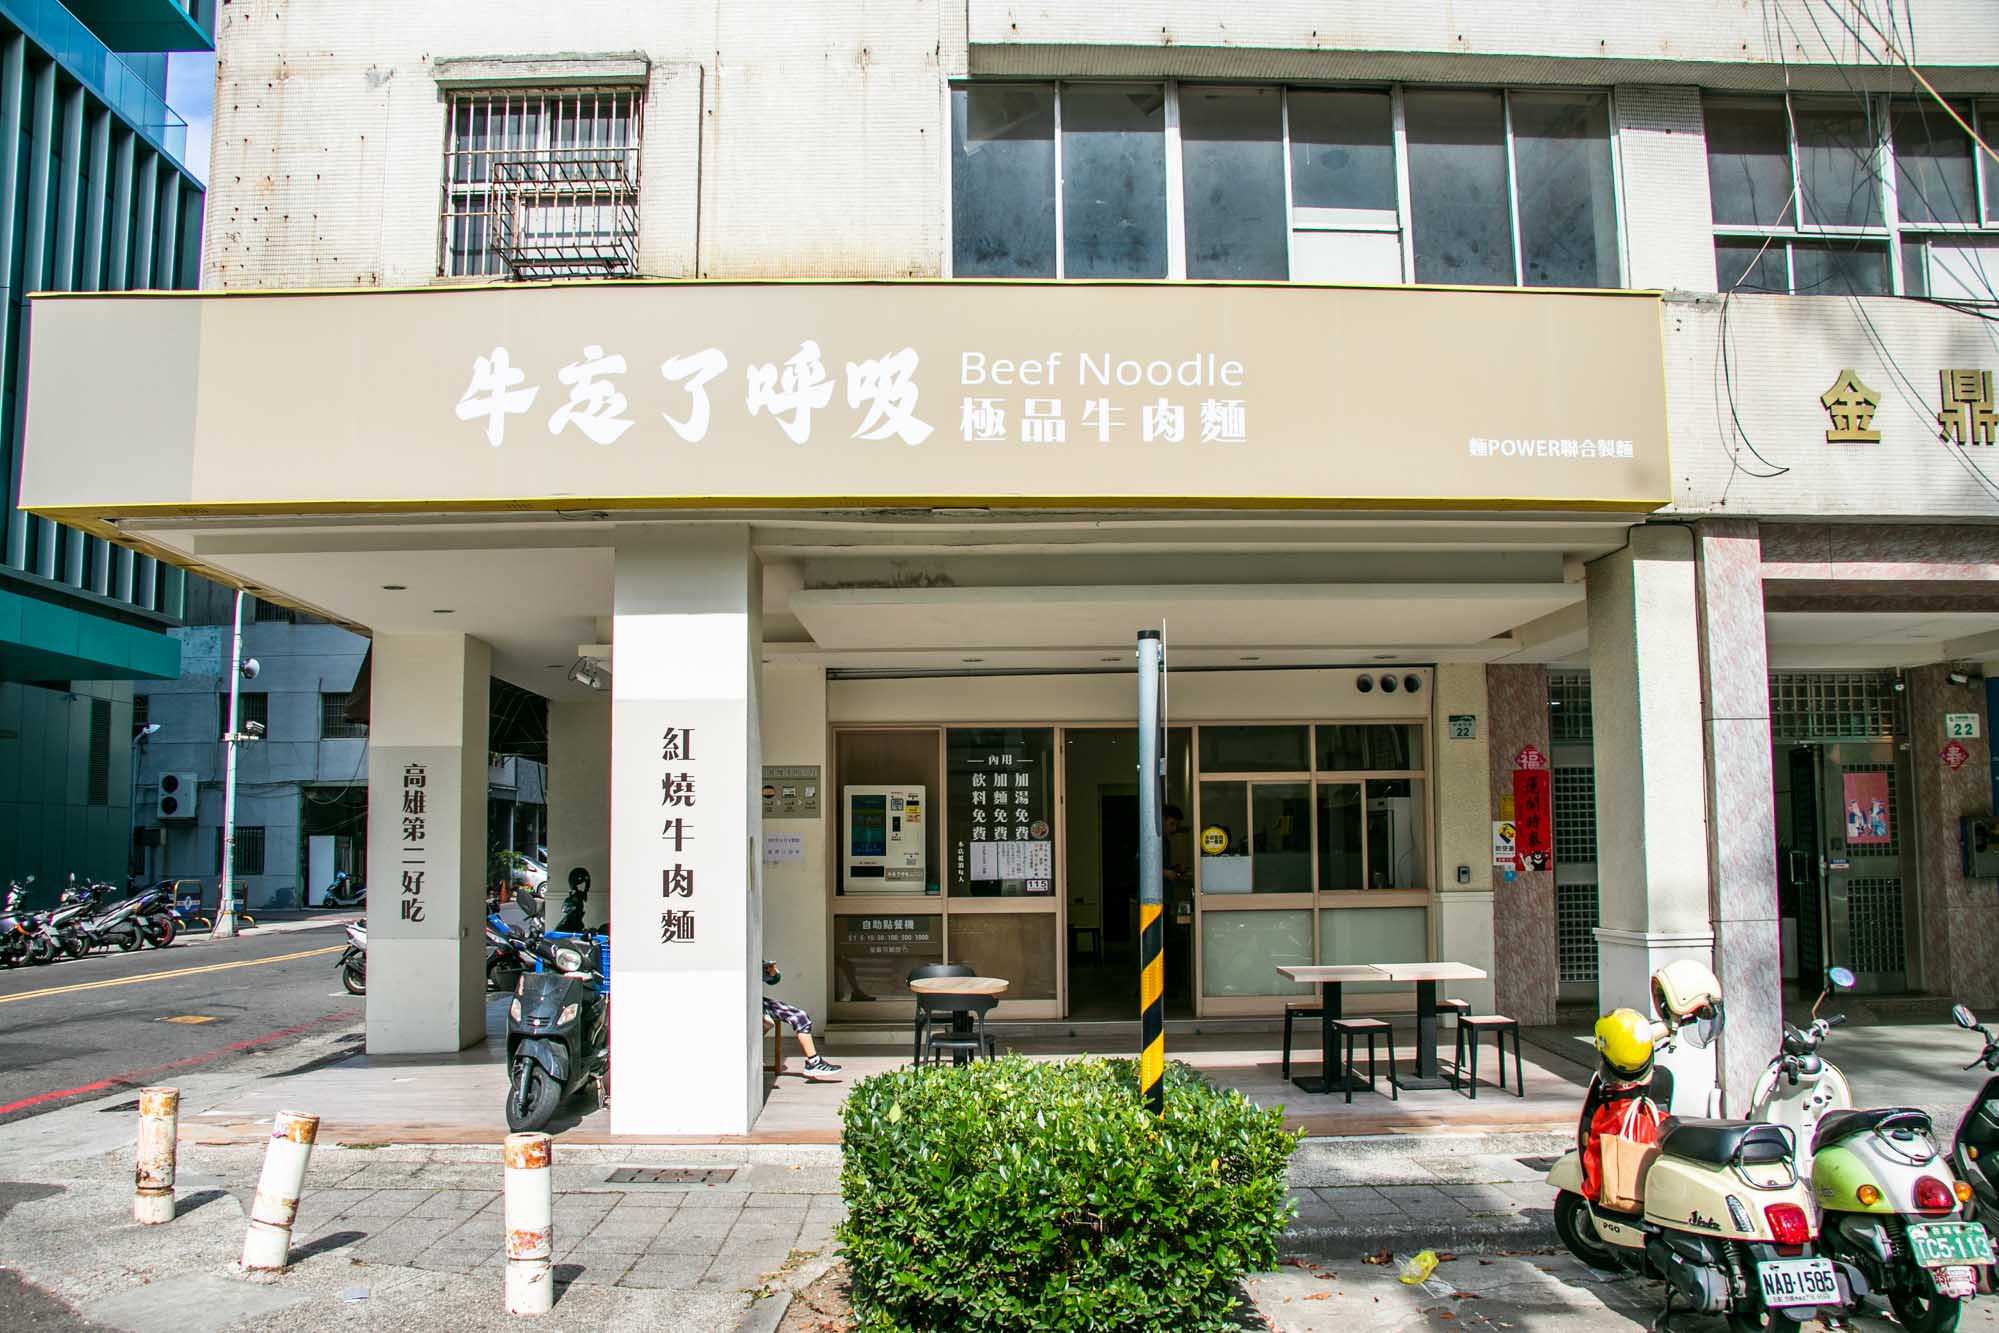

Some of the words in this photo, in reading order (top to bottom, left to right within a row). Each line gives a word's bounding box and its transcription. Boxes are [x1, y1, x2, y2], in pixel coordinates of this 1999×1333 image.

[455, 340, 935, 447] 牛忘了呼吸
[961, 351, 1063, 385] Beef
[1079, 352, 1244, 386] Noodle
[960, 398, 1248, 442] 極品牛肉麵
[1456, 727, 1470, 737] 22
[1954, 723, 1973, 736] 22
[972, 773, 987, 841] 飲料免費
[1015, 773, 1030, 841] 加湯免費
[401, 763, 427, 923] 高雄第二好吃
[661, 727, 696, 944] 紅燒牛肉麵
[1602, 1221, 1621, 1234] PGO
